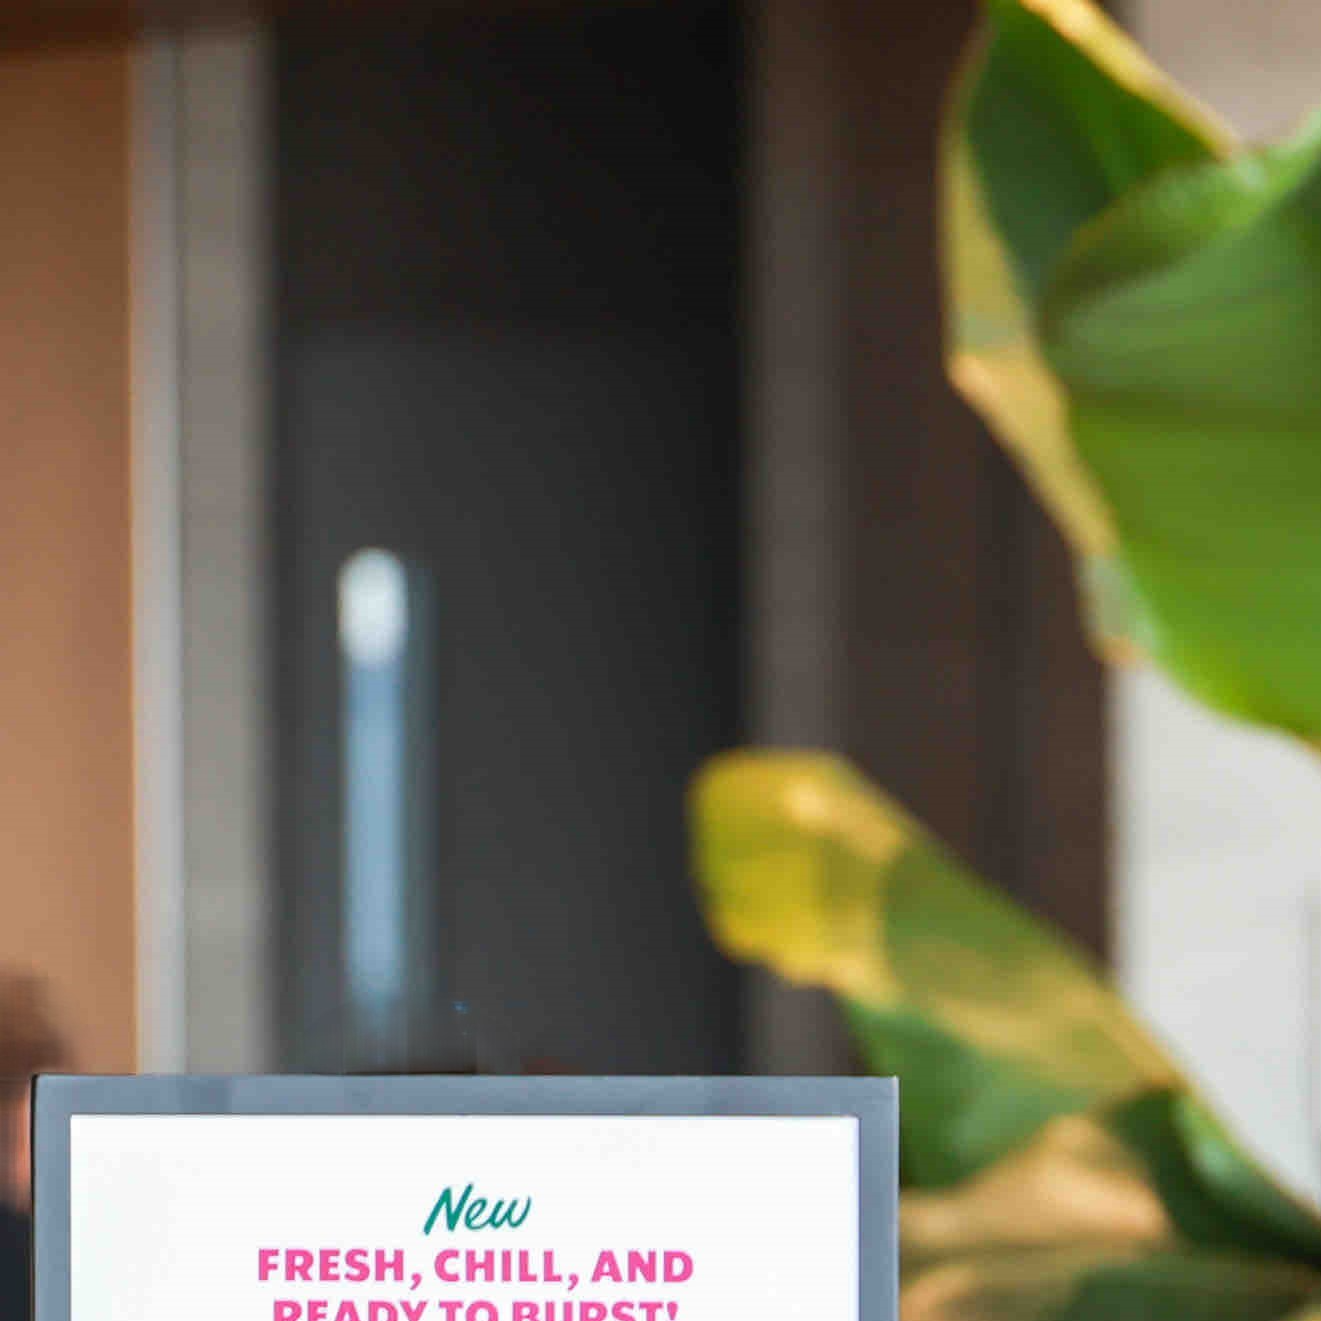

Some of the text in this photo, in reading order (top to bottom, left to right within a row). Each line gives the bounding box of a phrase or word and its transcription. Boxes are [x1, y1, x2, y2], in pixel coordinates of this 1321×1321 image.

[423, 1182, 531, 1236] New
[258, 1249, 694, 1291] FRESH, CHILL, AND
